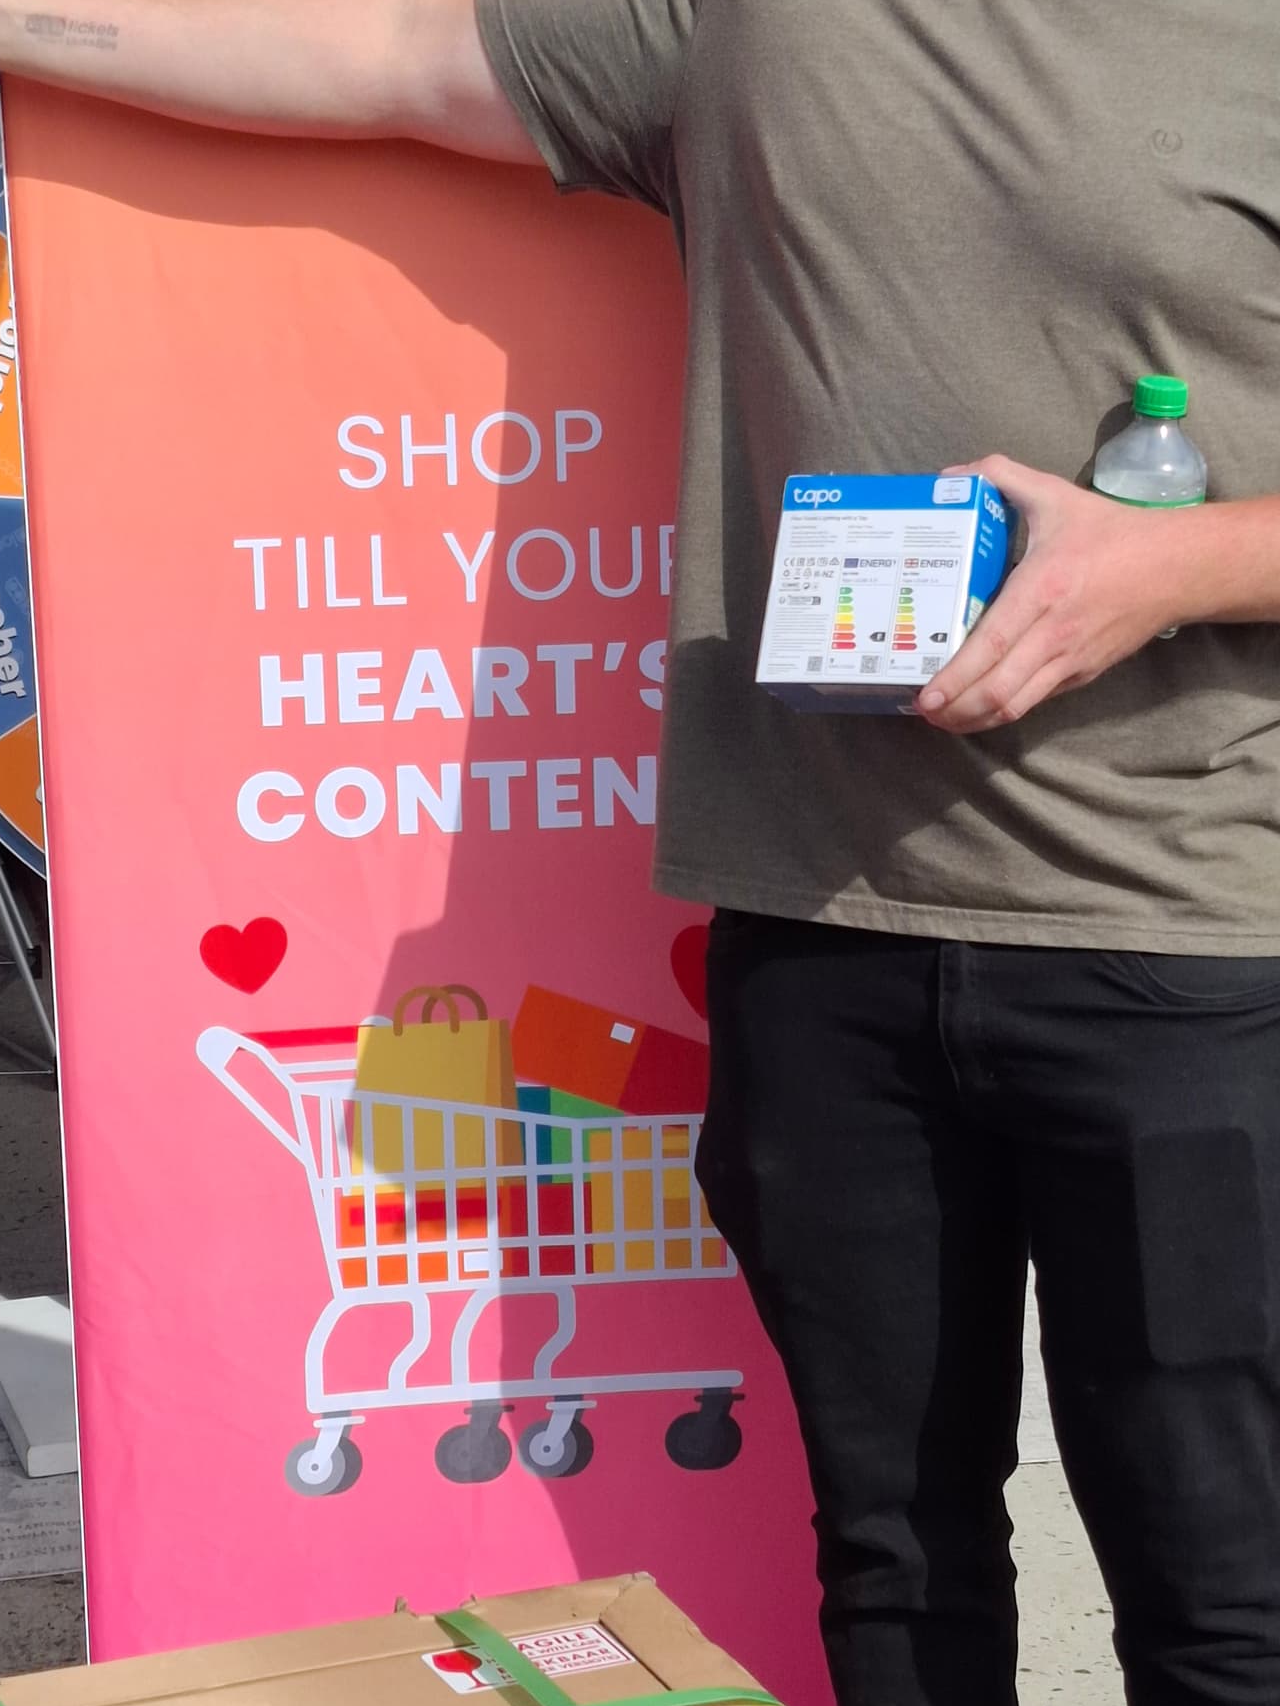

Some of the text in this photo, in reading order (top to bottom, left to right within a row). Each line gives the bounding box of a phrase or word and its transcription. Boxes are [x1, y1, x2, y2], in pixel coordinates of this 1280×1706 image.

[337, 409, 604, 490] SHOP
[792, 487, 843, 509] tapo
[233, 535, 408, 611] TILL
[236, 755, 658, 843] CONTEN
[518, 1631, 591, 1653] AGILE
